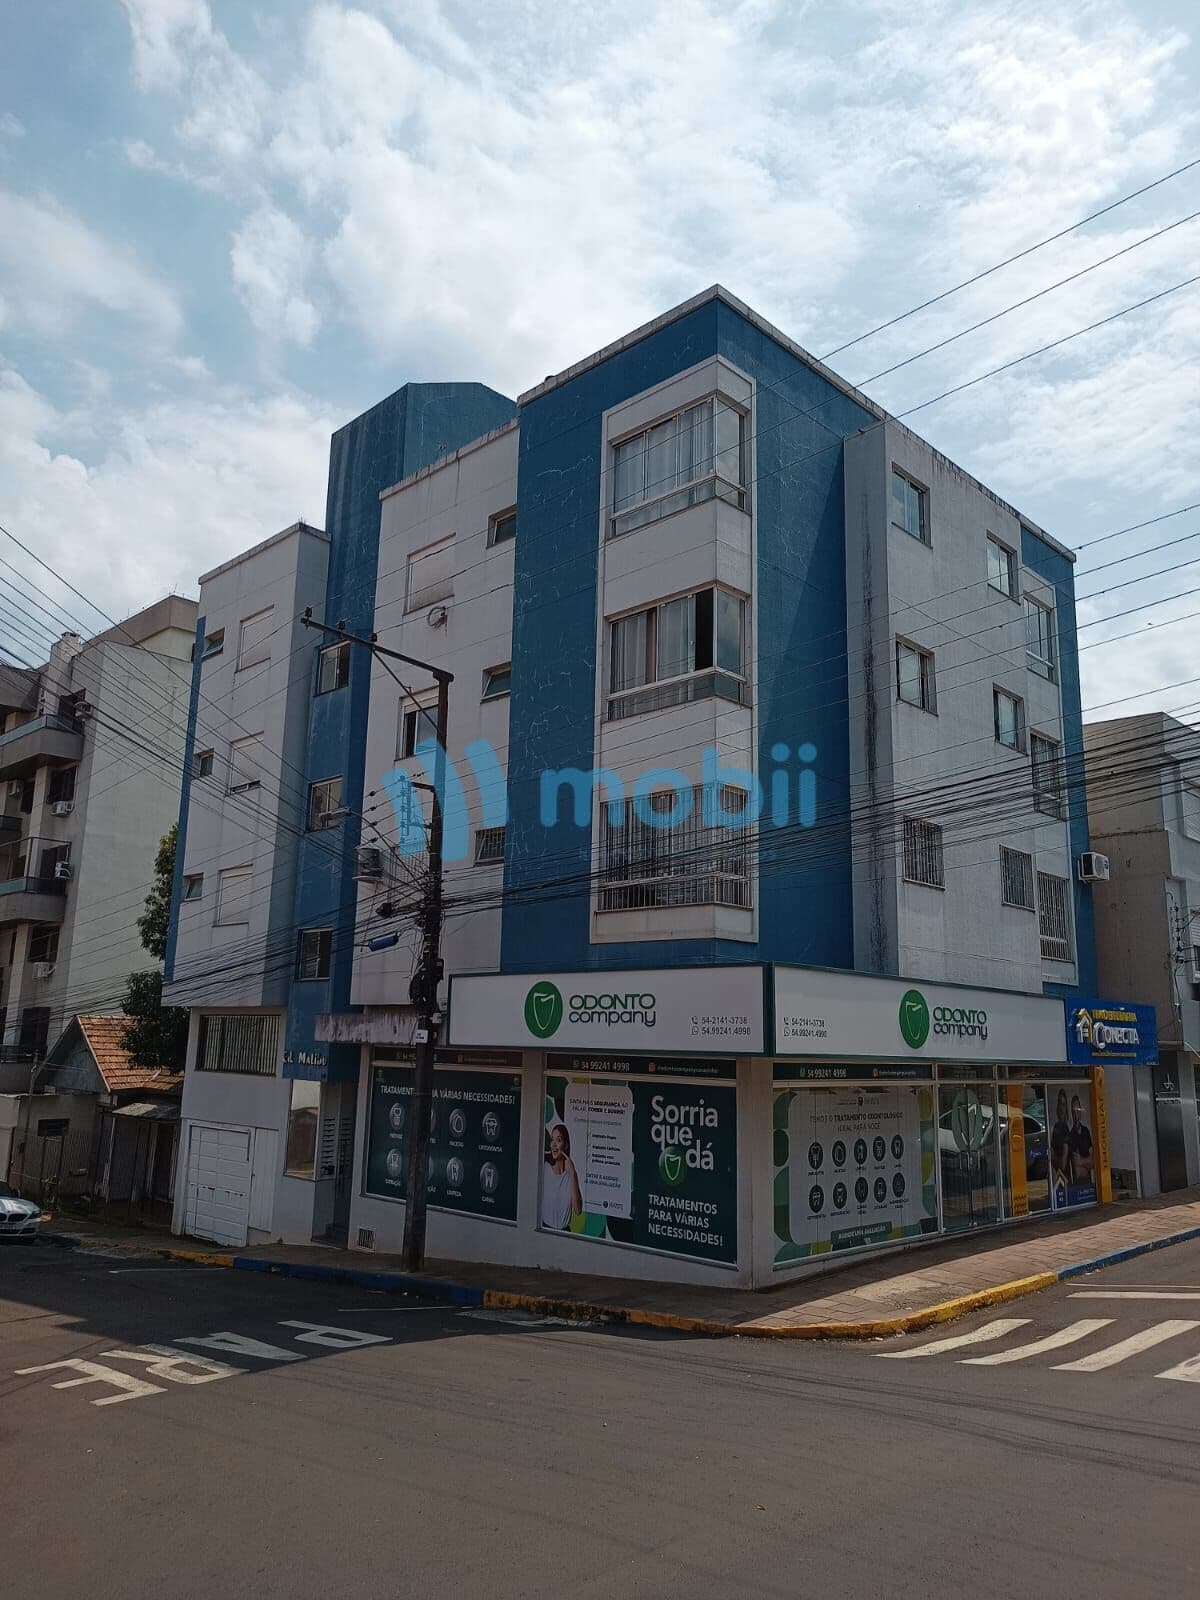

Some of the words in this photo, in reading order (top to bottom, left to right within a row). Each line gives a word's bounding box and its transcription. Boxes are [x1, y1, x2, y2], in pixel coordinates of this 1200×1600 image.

[569, 994, 656, 1010] ODONTO
[569, 1011, 656, 1027] company
[933, 1006, 987, 1025] ODONTO
[933, 1022, 988, 1041] company
[439, 1087, 462, 1100] VÁRIAS
[463, 1091, 516, 1105] NECESSIDADES!
[651, 1095, 719, 1128] Sorria
[651, 1124, 693, 1152] que
[685, 1139, 714, 1171] dá
[648, 1193, 718, 1215] TRATAMENTOS
[648, 1208, 673, 1223] PARA
[674, 1212, 710, 1229] VÁRIAS
[648, 1222, 723, 1247] NECESSIDADES!
